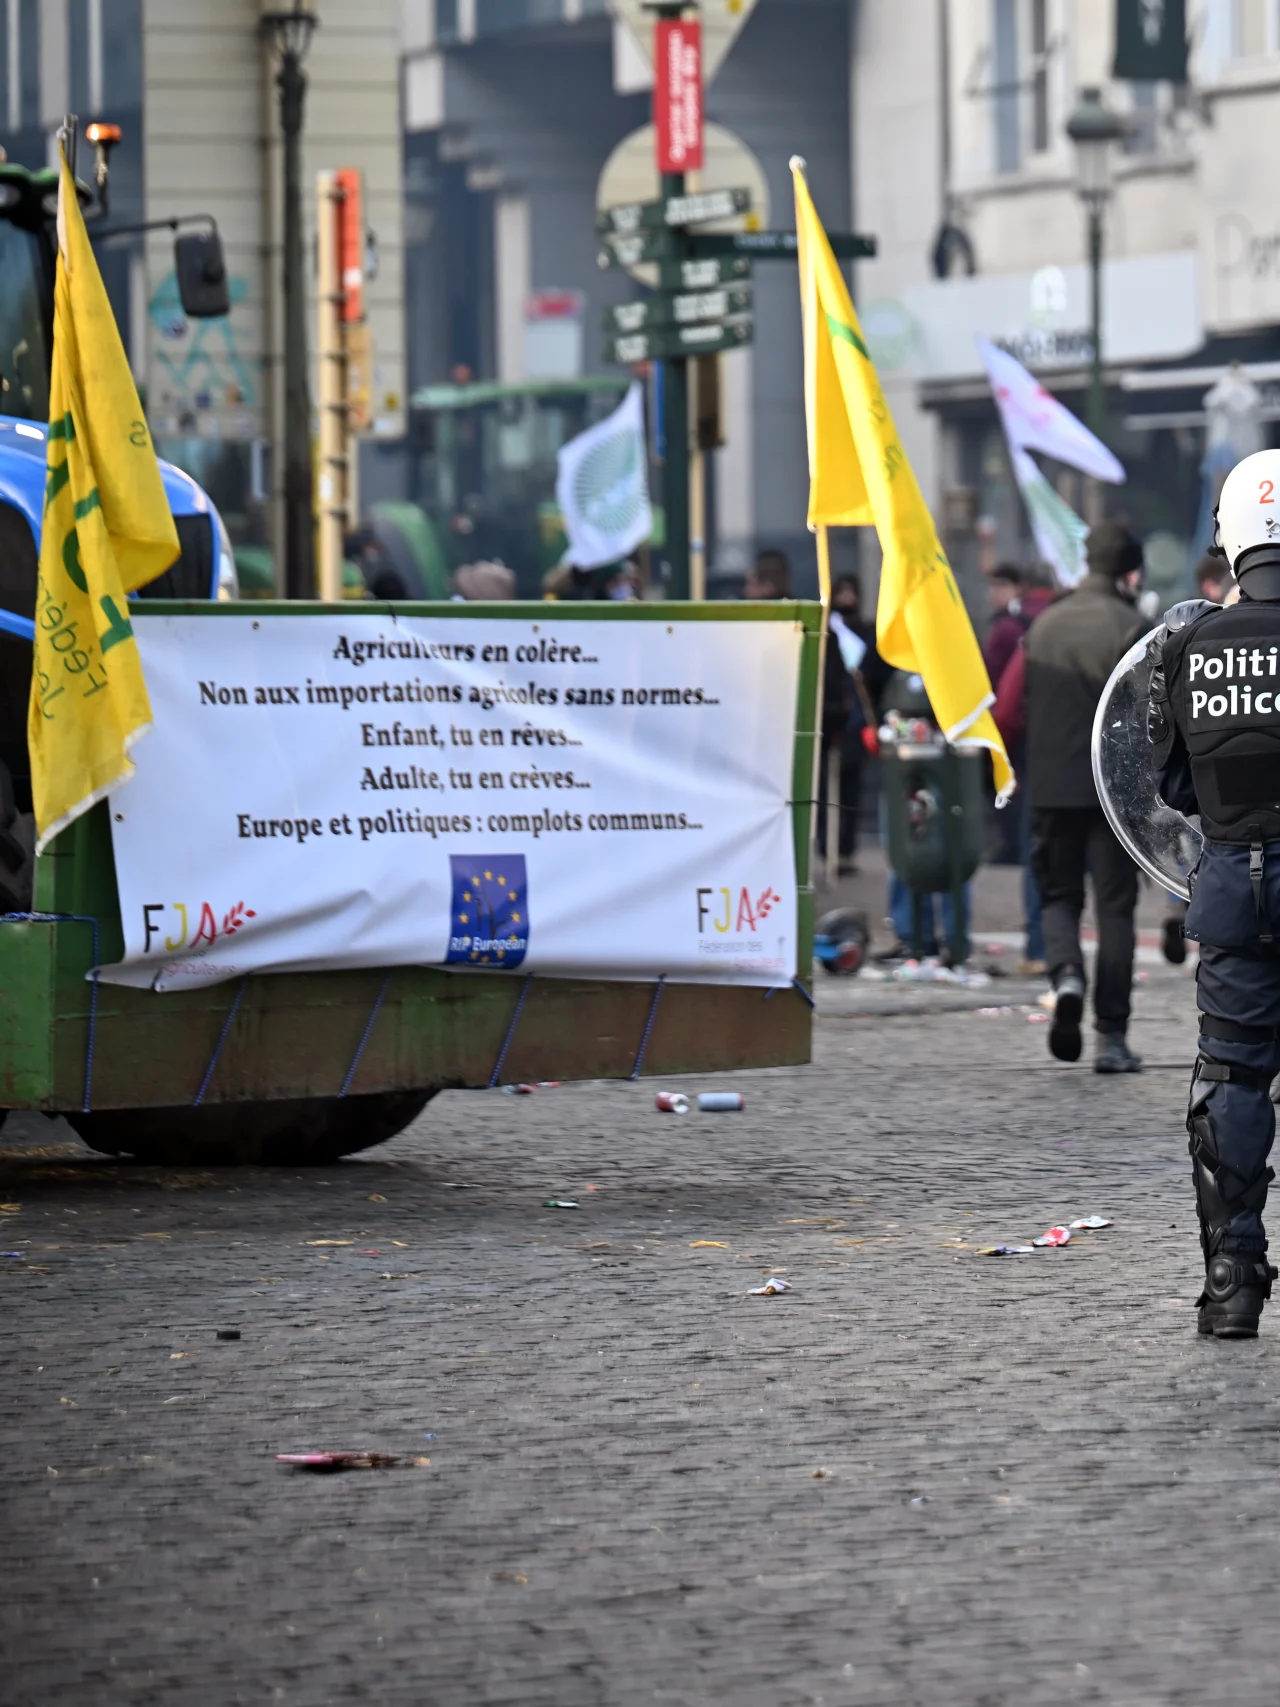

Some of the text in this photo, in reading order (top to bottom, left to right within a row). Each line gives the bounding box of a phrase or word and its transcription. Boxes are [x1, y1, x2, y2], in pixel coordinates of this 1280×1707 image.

[1258, 479, 1275, 505] 2
[332, 633, 599, 667] Agriculteurs en colère...
[198, 677, 720, 711] Non aux importations agricoles sans normes...
[360, 721, 583, 750] Enfant, tu en rêves...
[360, 763, 592, 794] Adulte, tu en crèves...
[236, 812, 323, 844] Europe
[328, 813, 354, 836] et
[358, 806, 472, 841] politiques
[487, 807, 583, 839] complots
[588, 811, 704, 833] communs...
[696, 886, 757, 933] FJA
[143, 901, 217, 953] FJA
[449, 936, 526, 952] RIP European
